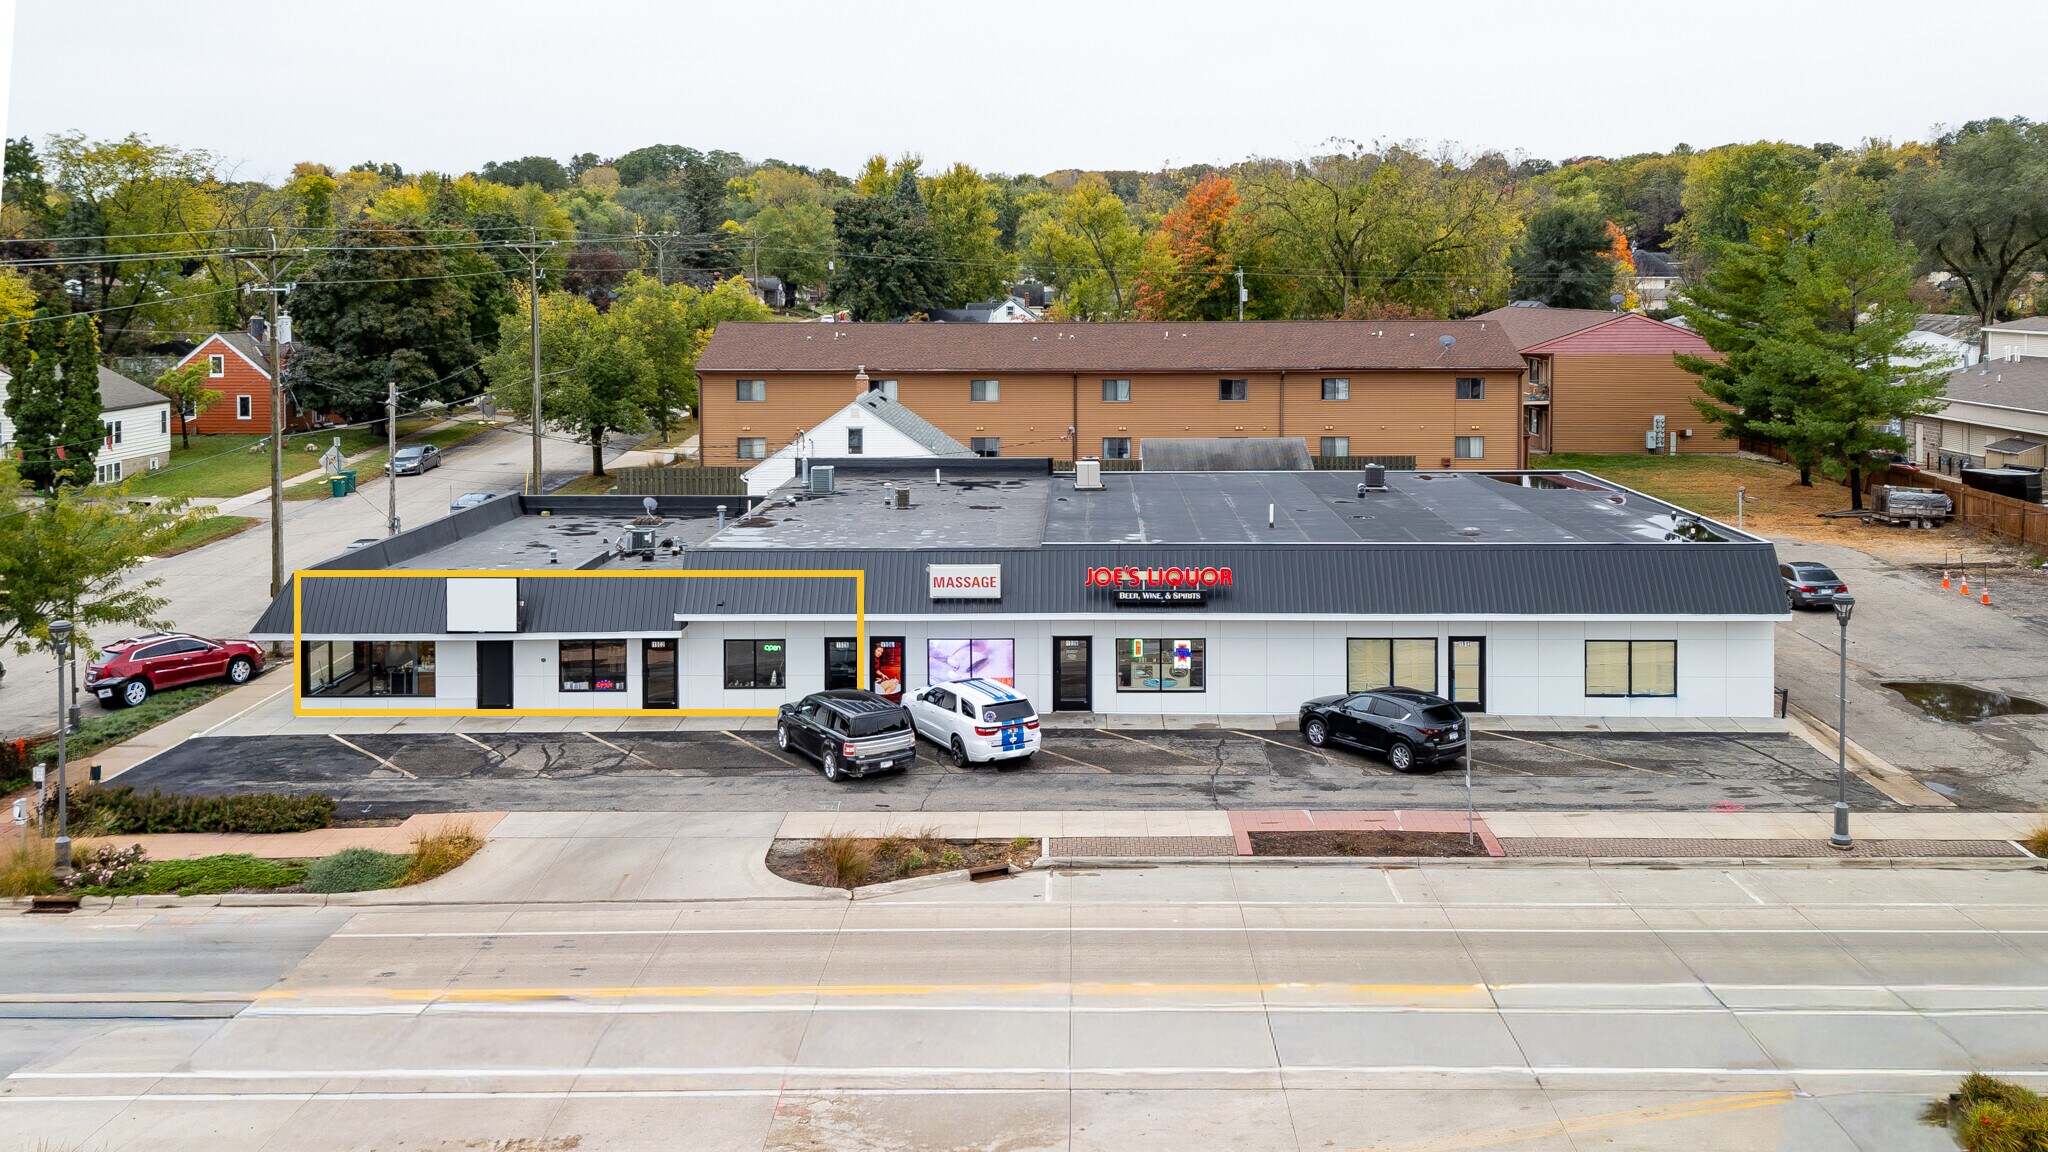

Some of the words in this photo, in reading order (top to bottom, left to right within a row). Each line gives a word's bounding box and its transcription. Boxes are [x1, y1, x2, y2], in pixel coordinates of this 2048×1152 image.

[933, 576, 996, 588] MASSAGE
[1085, 565, 1140, 587] JOE'S
[1146, 567, 1232, 587] LIQUOR
[1165, 592, 1171, 600] &
[1172, 592, 1201, 600] SPIRITS
